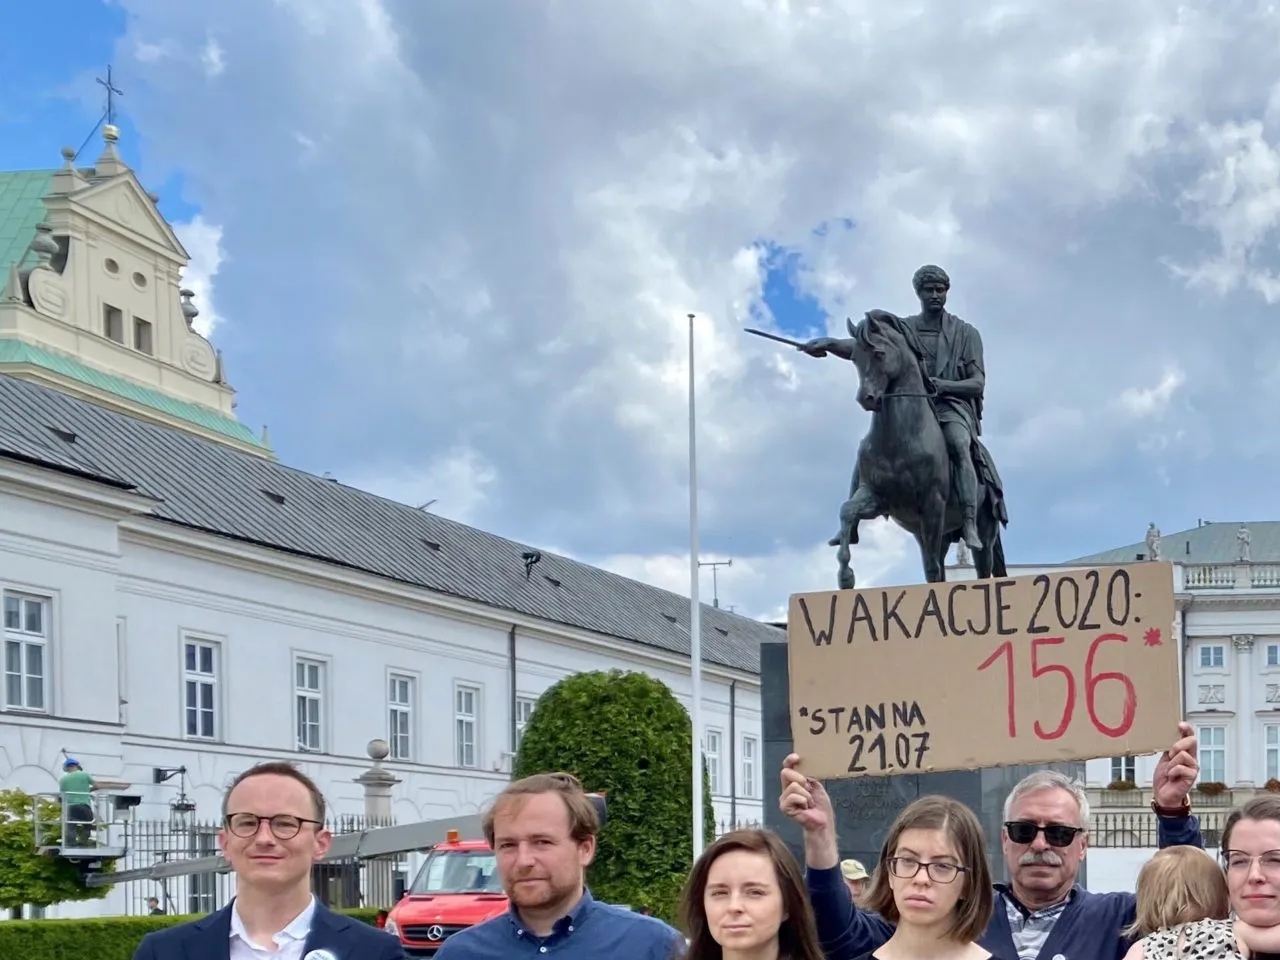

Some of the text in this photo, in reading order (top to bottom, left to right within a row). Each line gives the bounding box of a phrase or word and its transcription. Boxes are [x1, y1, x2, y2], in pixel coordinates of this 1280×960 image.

[799, 569, 1142, 646] WAKACJE 2020:
[848, 732, 931, 772] 21.07
